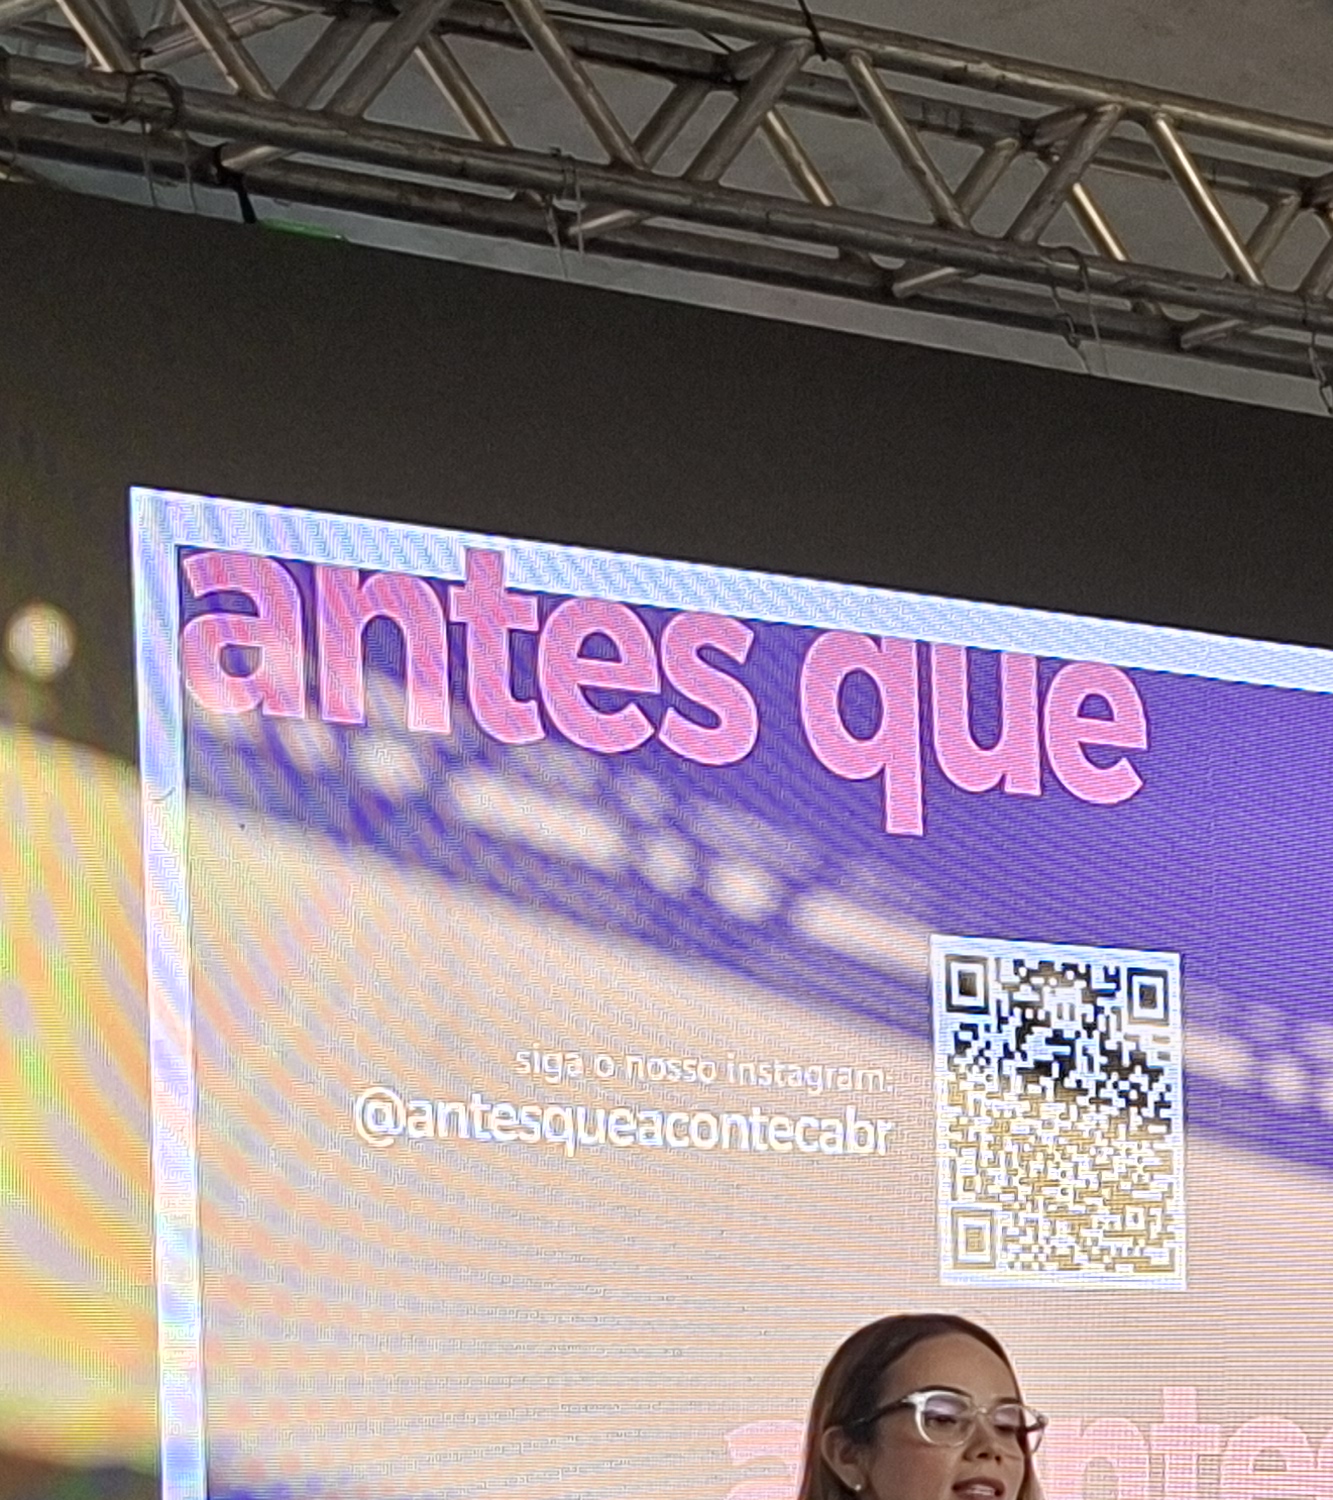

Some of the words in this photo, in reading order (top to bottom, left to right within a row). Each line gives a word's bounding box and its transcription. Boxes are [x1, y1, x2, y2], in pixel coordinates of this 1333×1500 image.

[182, 547, 760, 766] antes
[801, 629, 1149, 837] que
[515, 1041, 584, 1084] siga
[594, 1053, 615, 1078] o
[625, 1054, 717, 1084] nosso
[727, 1052, 895, 1095] instagram:
[355, 1086, 895, 1158] @antesqueacontecabr
